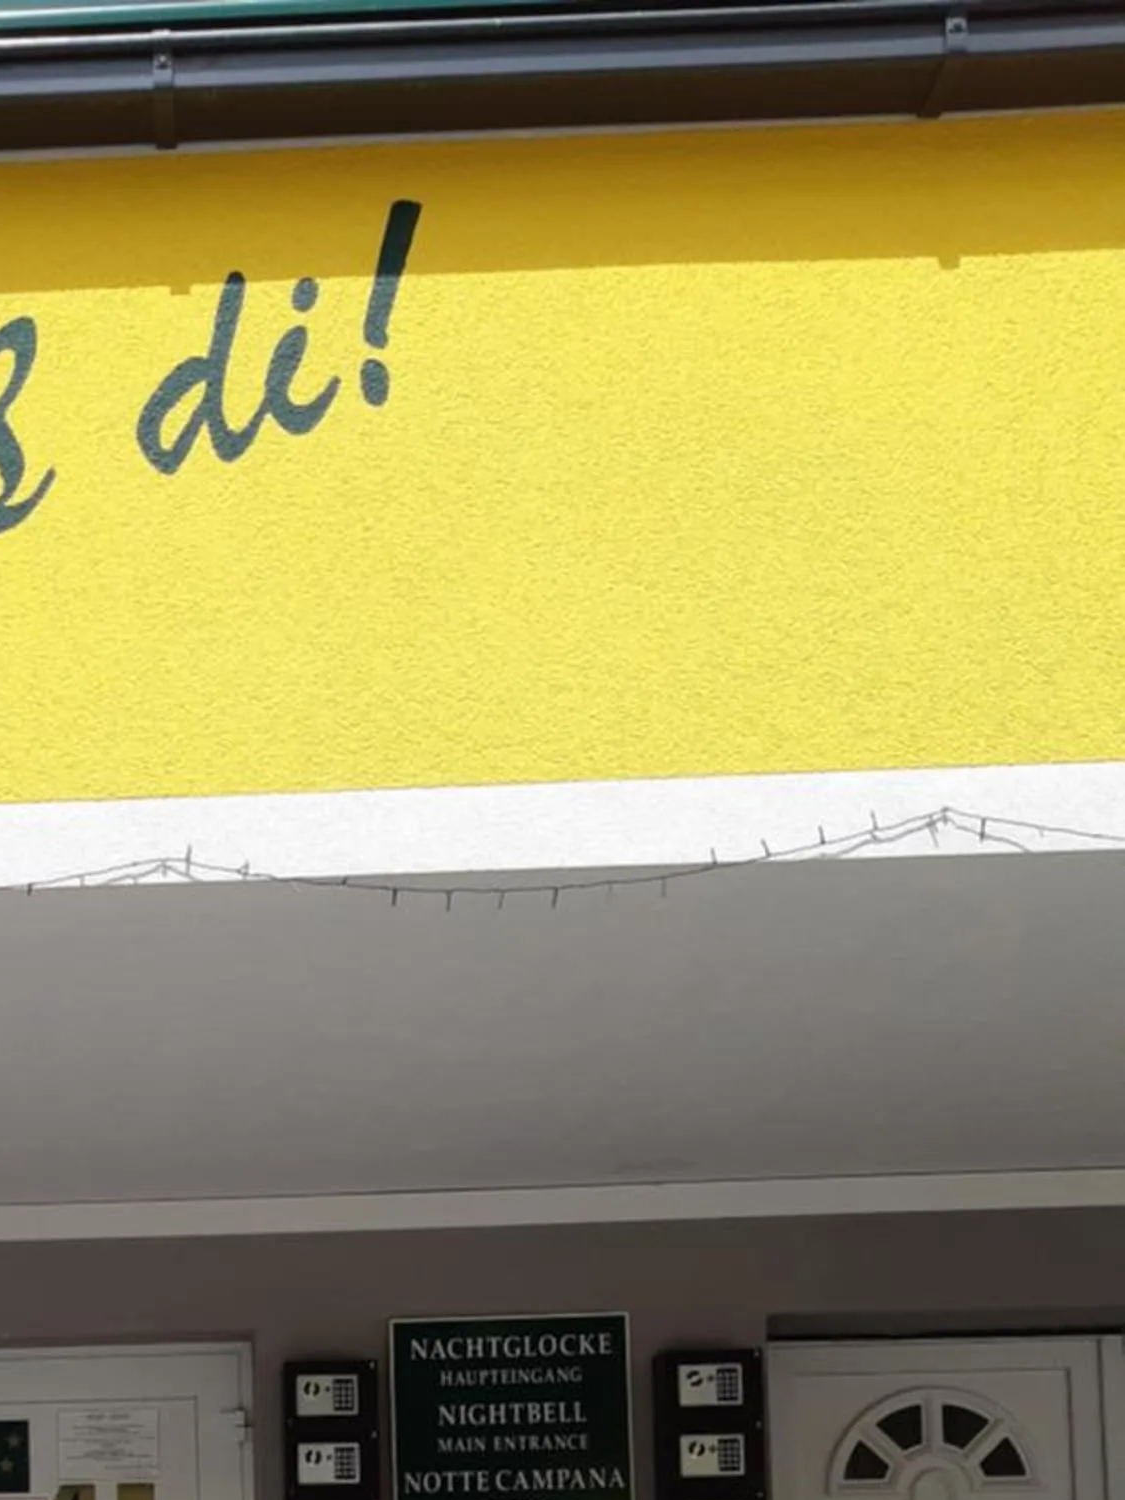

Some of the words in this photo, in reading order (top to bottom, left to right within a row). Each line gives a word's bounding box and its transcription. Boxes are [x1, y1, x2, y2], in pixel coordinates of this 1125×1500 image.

[137, 199, 421, 475] di!
[410, 1333, 612, 1360] NACHTGLOCKE
[440, 1367, 582, 1386] HAUPTEINGANG
[438, 1401, 587, 1425] NIGHTBELL
[437, 1437, 487, 1452] MAIN
[494, 1434, 587, 1451] ENTRANCE
[404, 1470, 489, 1493] NOTTE
[495, 1468, 625, 1491] CAMPANA
